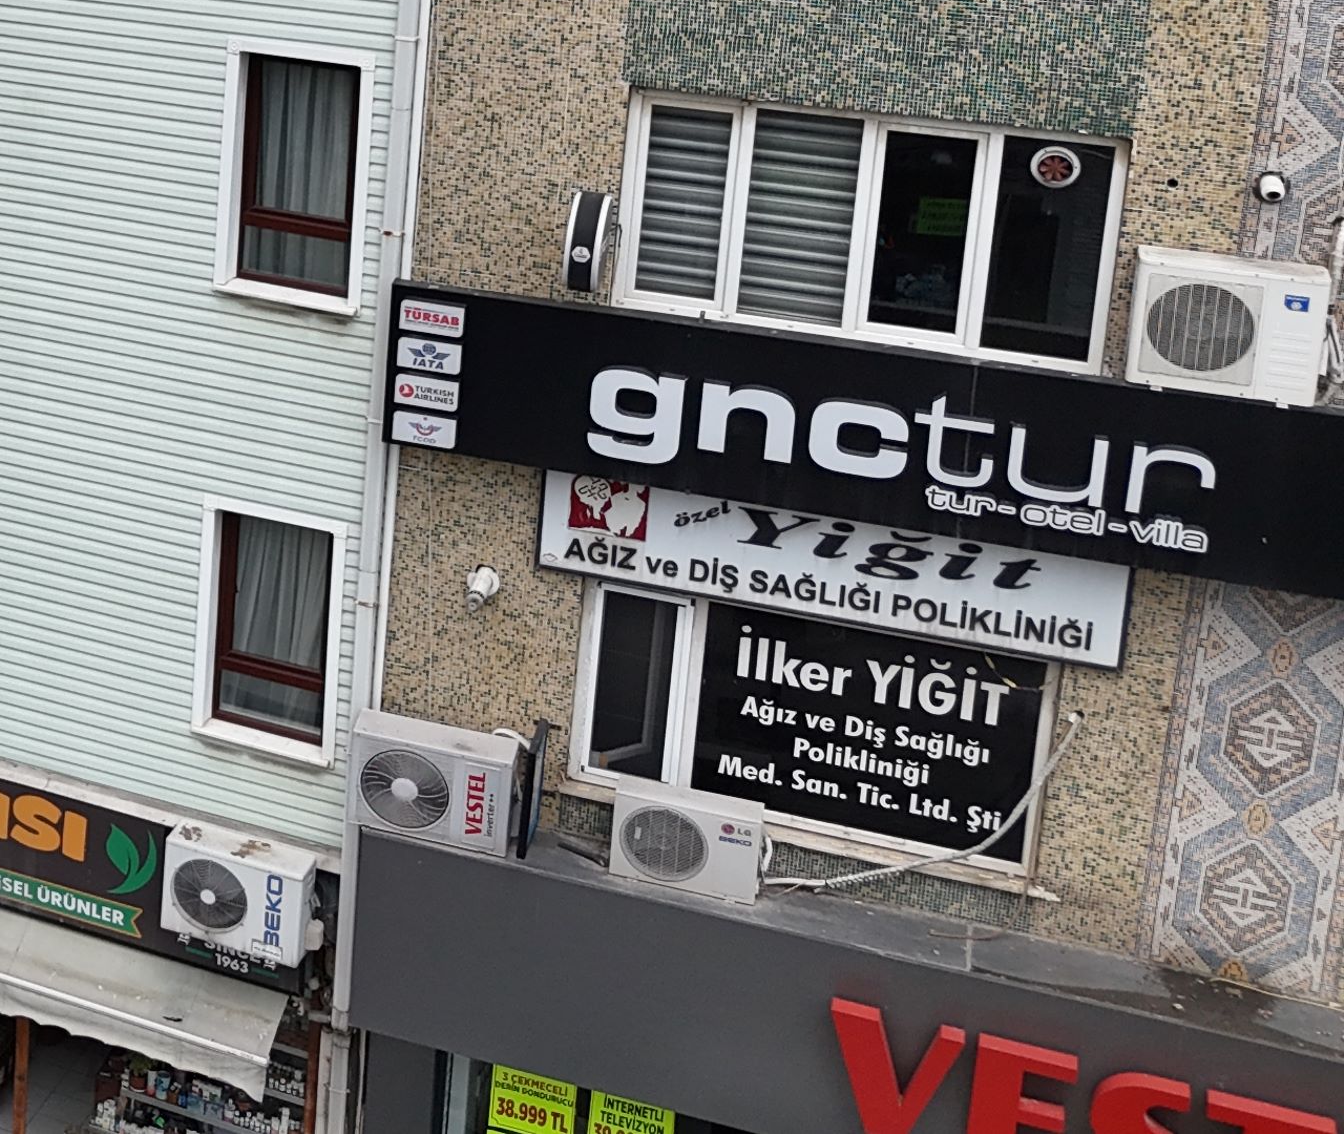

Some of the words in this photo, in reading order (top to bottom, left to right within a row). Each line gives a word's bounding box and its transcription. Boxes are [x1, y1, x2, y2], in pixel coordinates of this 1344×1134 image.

[404, 306, 460, 327] TÜRSAB
[412, 357, 444, 370] IATA
[414, 393, 454, 405] AIRLINES
[415, 385, 455, 398] TURKISH
[673, 500, 731, 528] özel
[737, 506, 1041, 590] Yiğit
[564, 536, 638, 570] AĞIZ
[646, 555, 679, 578] ve
[689, 557, 739, 593] DİŞ
[749, 569, 881, 614] SAĞLIĞI
[891, 593, 1094, 651] POLİKLİNİĞİ
[736, 625, 853, 696] İlker
[866, 655, 1010, 727] YİĞİT
[740, 696, 797, 726] Ağız
[805, 713, 836, 733] ve
[844, 715, 886, 749] Diş
[894, 726, 990, 768] Sağlığı
[792, 737, 930, 788] Polikliniği
[465, 772, 486, 837] VESTEL
[717, 754, 783, 786] Med.
[791, 769, 847, 800] San.
[857, 782, 900, 811] Tic.
[909, 793, 958, 822] Ltd.
[719, 835, 752, 847] BEKO
[737, 828, 752, 837] LG
[37, 884, 125, 926] ÜRÜNLER
[263, 875, 284, 948] BEKO
[215, 953, 249, 973] 1963
[502, 1071, 509, 1082] 3
[511, 1074, 569, 1097] ÇEKMECELİ
[521, 1086, 574, 1108] DONDURUCU
[496, 1096, 547, 1127] 38.999
[551, 1111, 569, 1134] TL
